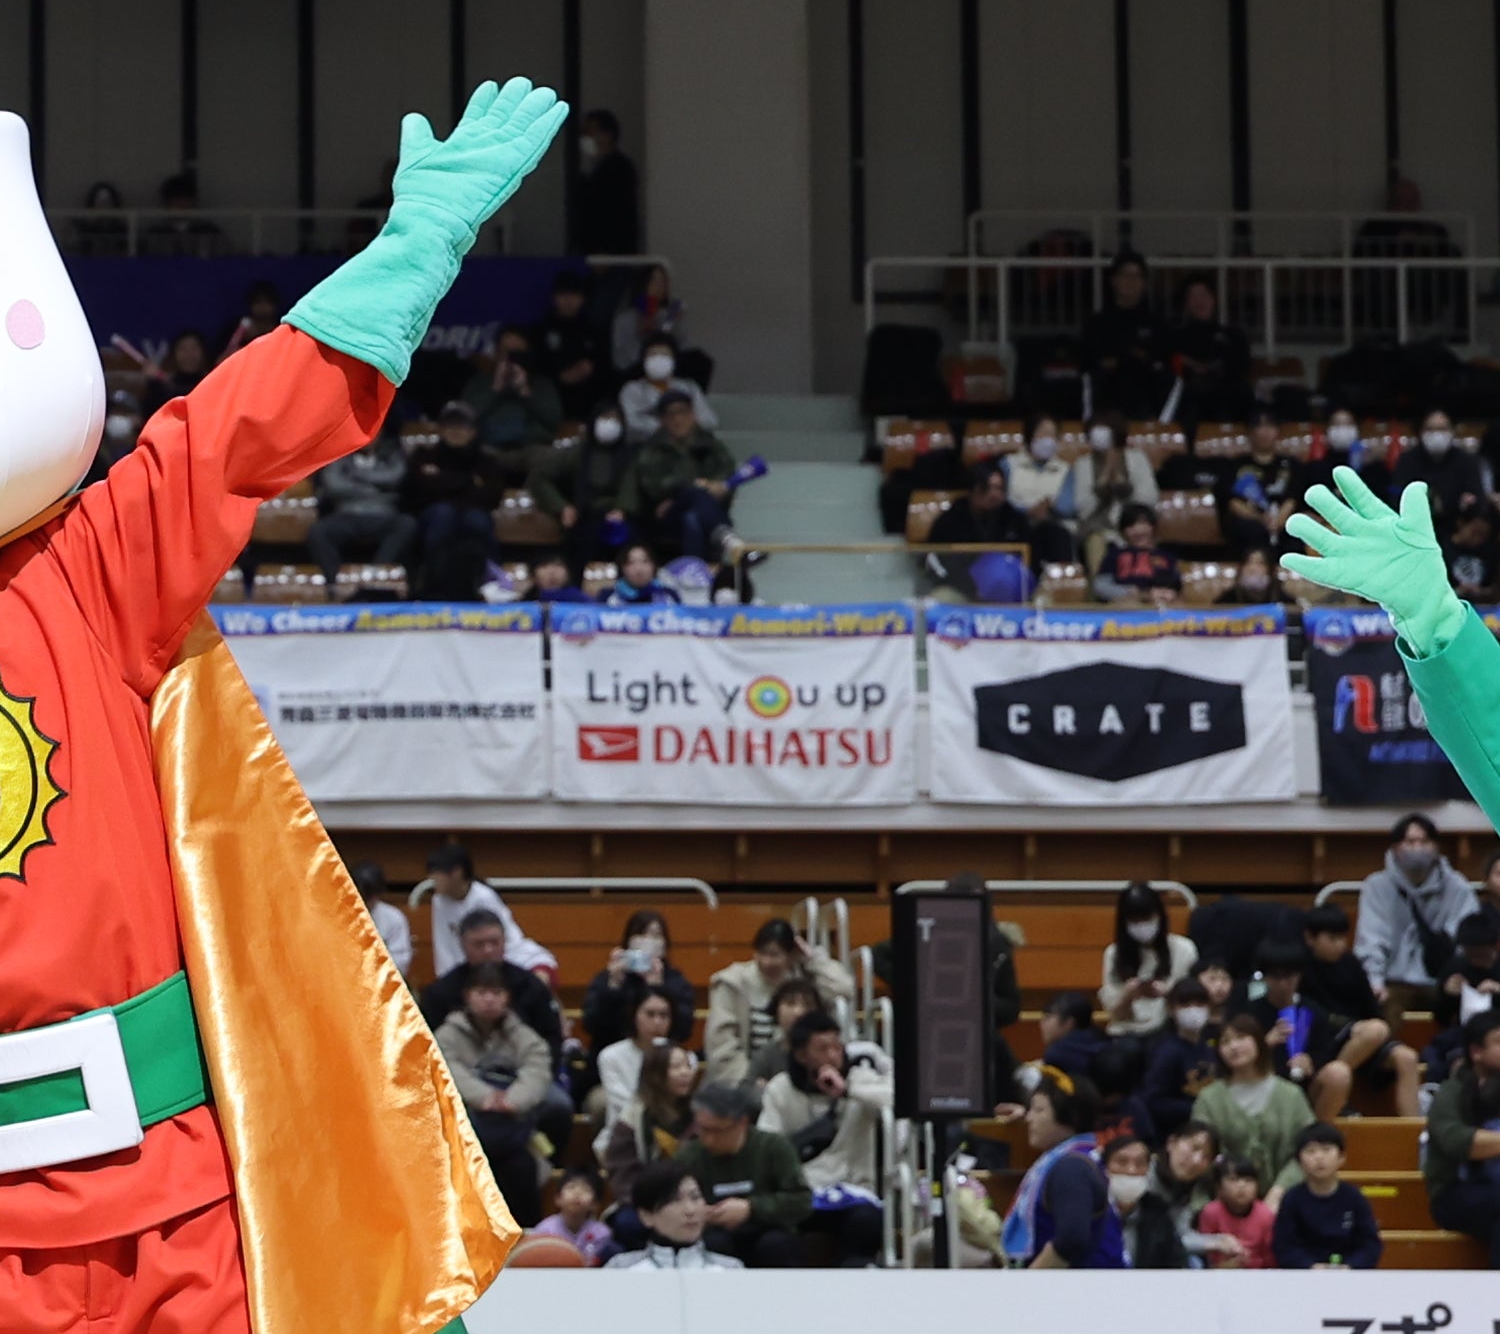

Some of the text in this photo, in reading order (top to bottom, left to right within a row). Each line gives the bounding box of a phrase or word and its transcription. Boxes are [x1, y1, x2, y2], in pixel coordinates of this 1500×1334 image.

[586, 670, 697, 713] Light
[834, 682, 887, 713] up
[1007, 701, 1211, 735] CRATE
[653, 724, 893, 767] DAIHATSU
